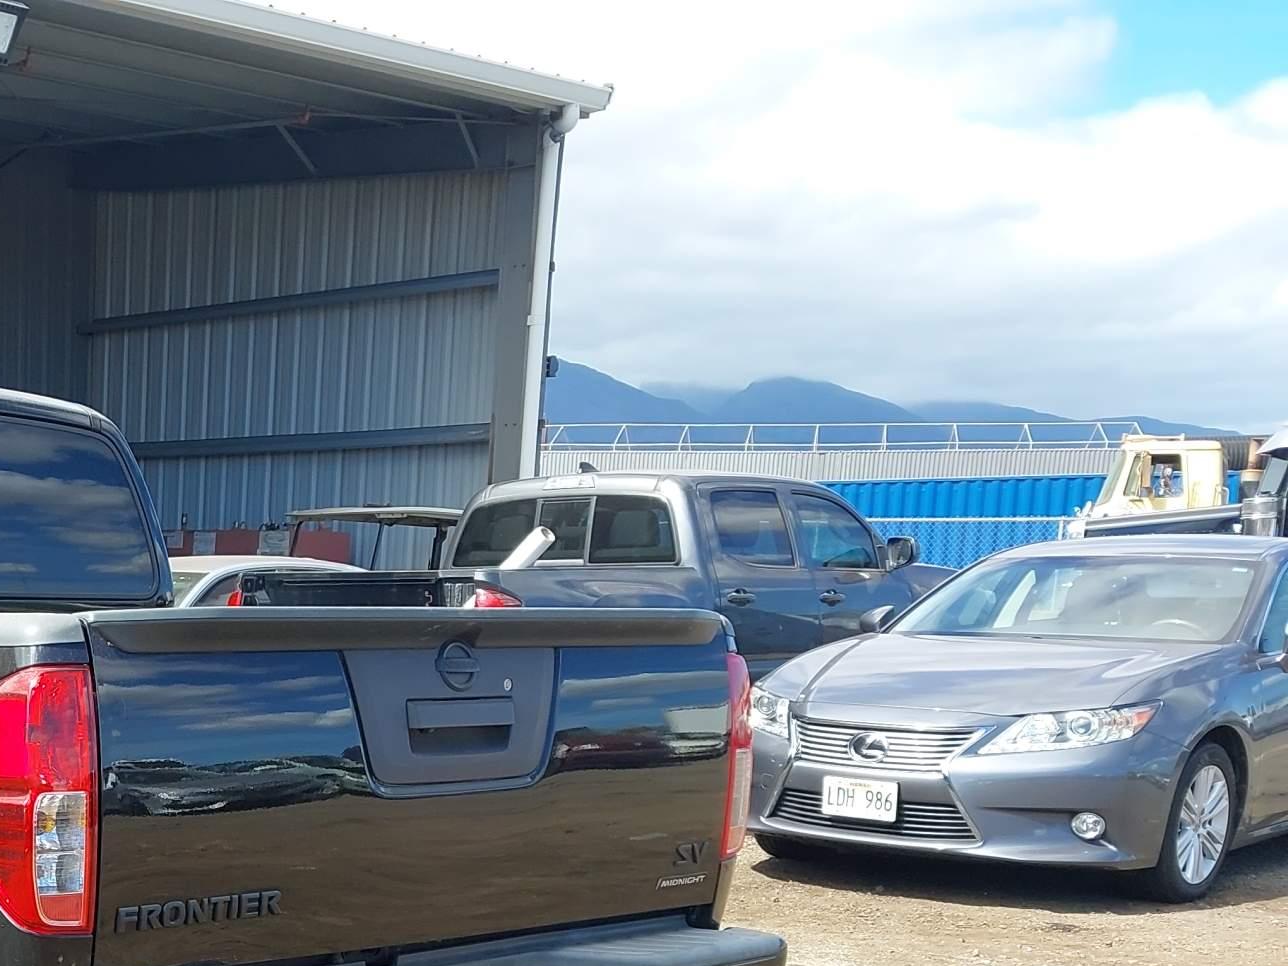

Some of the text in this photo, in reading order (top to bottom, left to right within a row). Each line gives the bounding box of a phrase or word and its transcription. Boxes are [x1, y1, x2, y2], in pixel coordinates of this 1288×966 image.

[827, 786, 893, 812] LDH 986
[673, 840, 707, 867] SV
[660, 875, 707, 888] MIDNIGHT
[113, 889, 282, 935] FRONTIER
